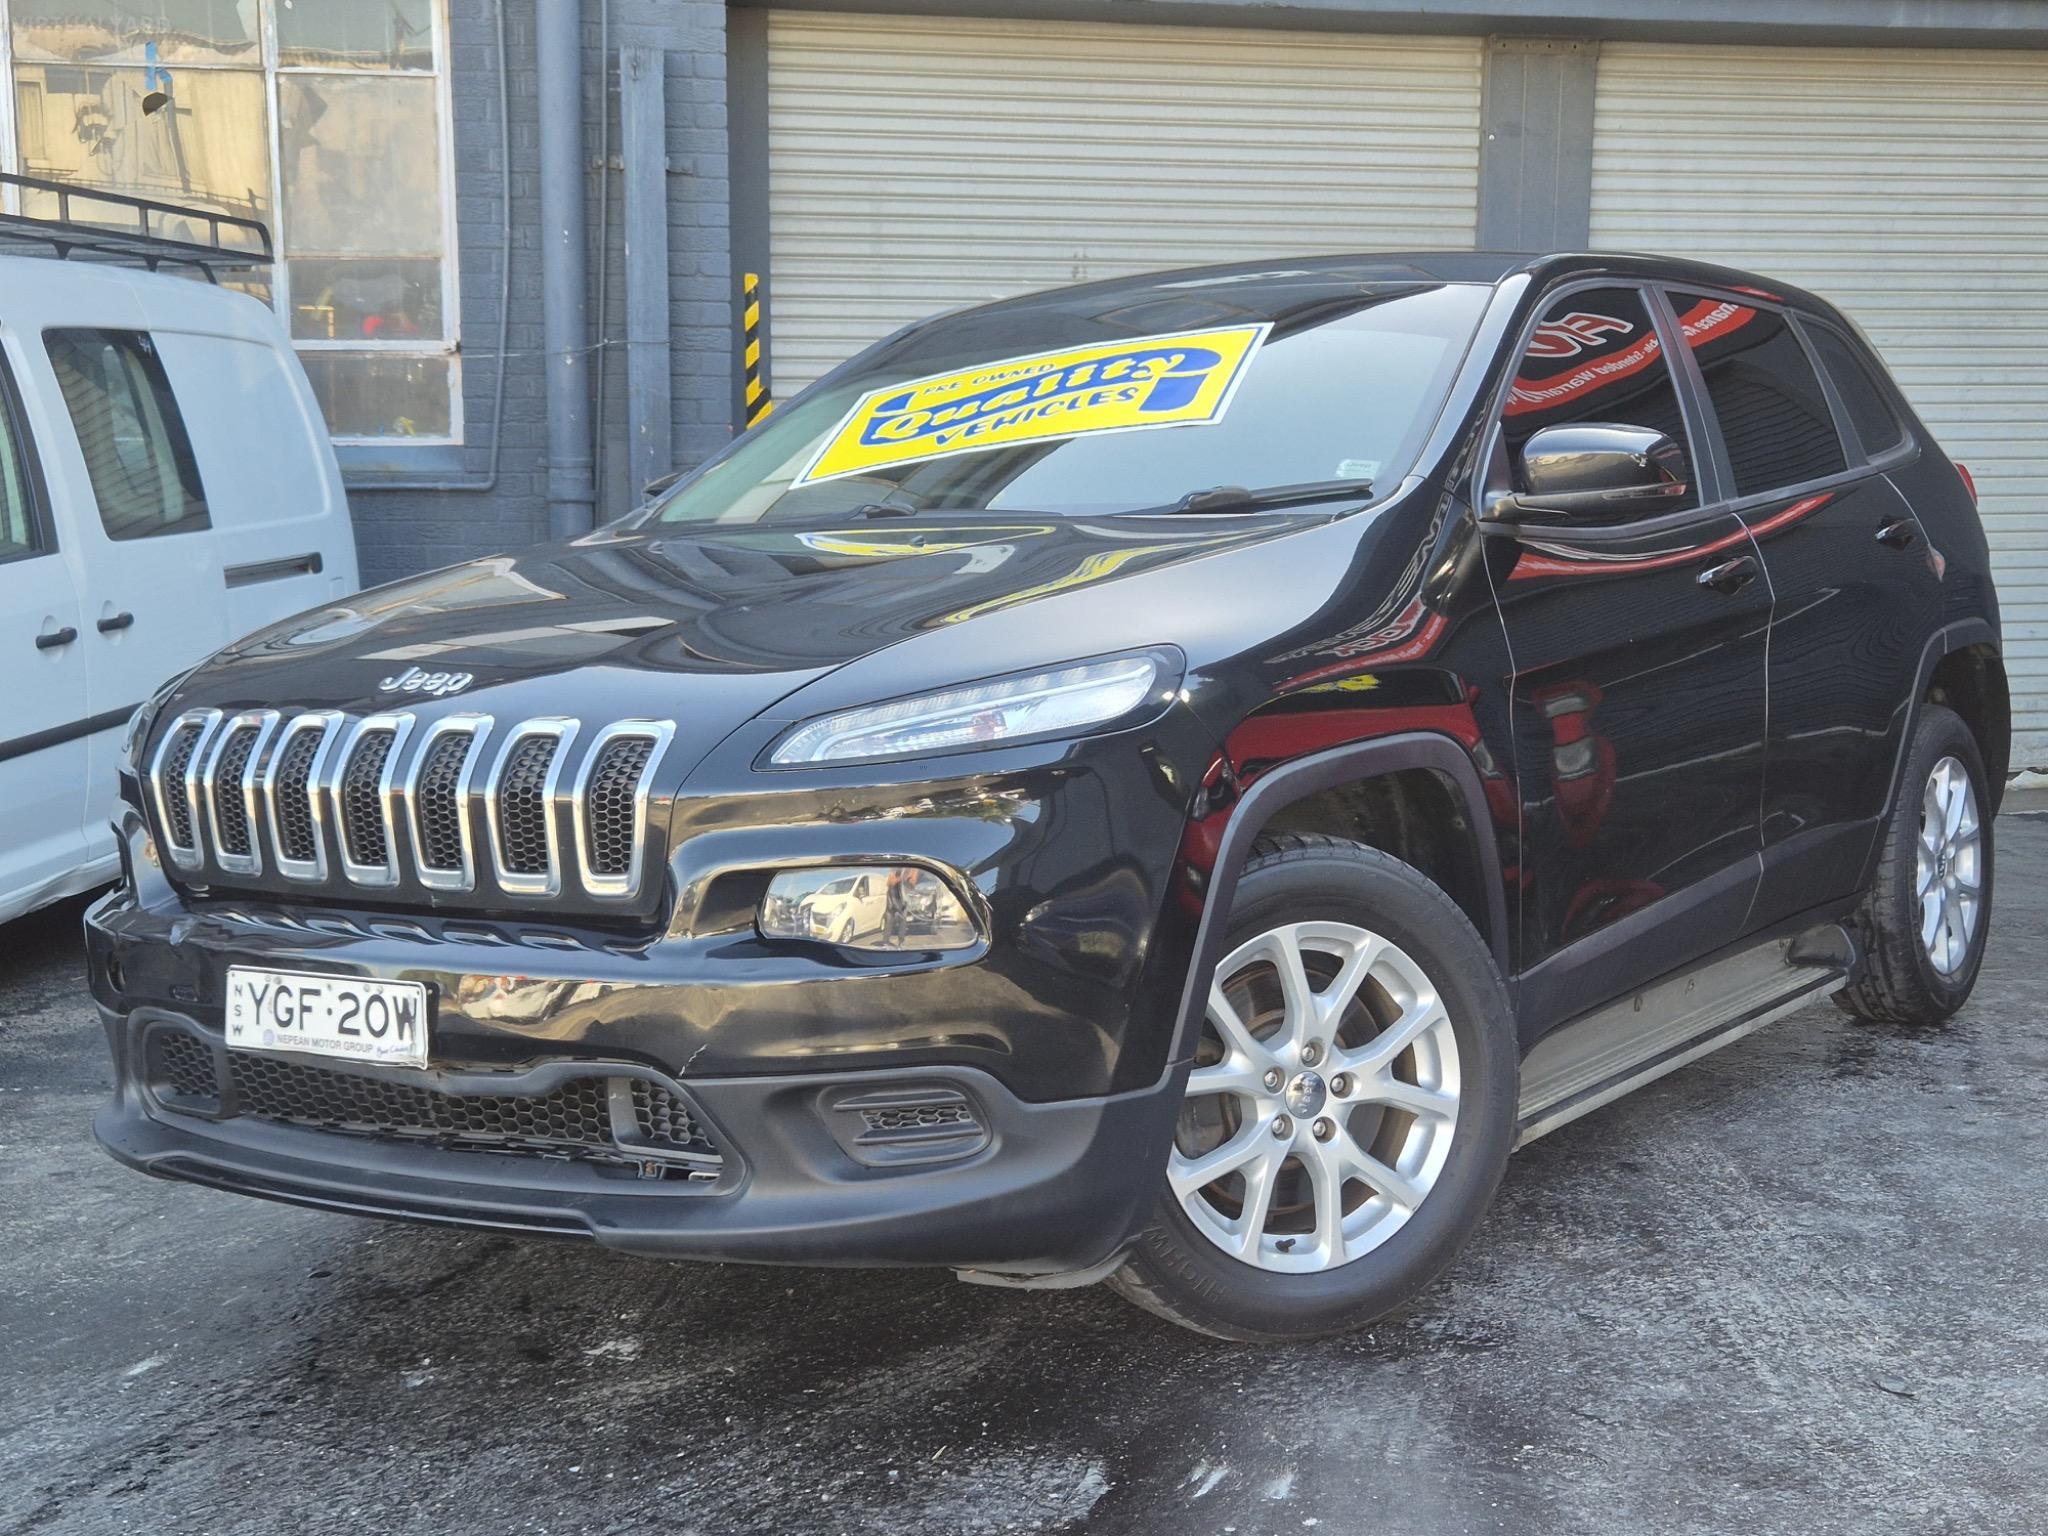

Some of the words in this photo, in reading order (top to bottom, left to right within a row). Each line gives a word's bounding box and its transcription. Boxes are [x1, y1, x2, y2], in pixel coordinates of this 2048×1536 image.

[870, 353, 1186, 440] Quality
[923, 381, 964, 395] PRE
[972, 363, 1056, 385] OWNED
[935, 386, 1140, 446] VEHICLES
[379, 666, 474, 696] Jeep
[231, 984, 244, 1037] NSW
[276, 1034, 310, 1047] NEPEAN
[311, 1036, 343, 1050] MOTOR
[343, 1039, 374, 1053] GROUP
